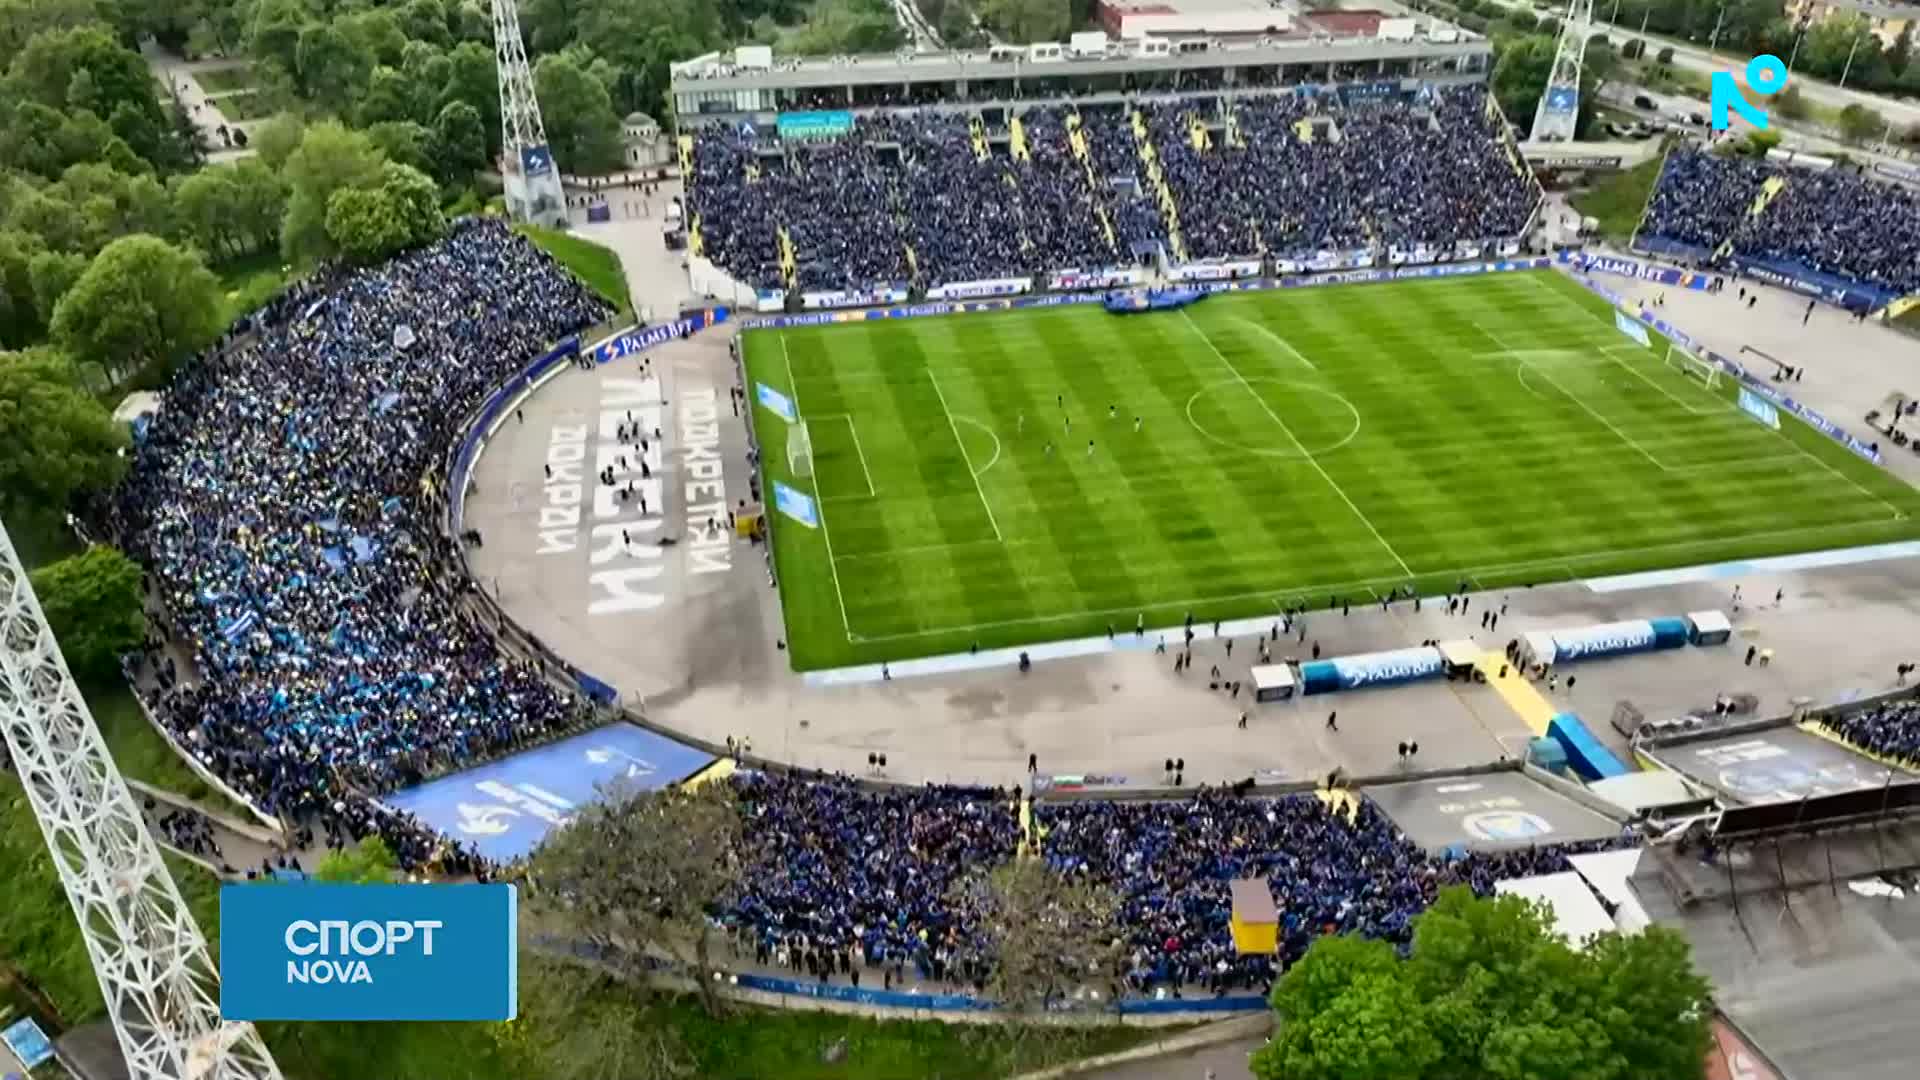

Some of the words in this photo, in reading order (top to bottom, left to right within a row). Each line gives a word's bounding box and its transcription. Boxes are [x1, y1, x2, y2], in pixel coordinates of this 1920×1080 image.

[1585, 254, 1632, 276] PALMS
[1635, 263, 1665, 281] BET
[621, 328, 668, 355] PALMS
[667, 319, 693, 338] BET
[1584, 636, 1625, 654] PALMS
[1366, 665, 1411, 682] PALMS
